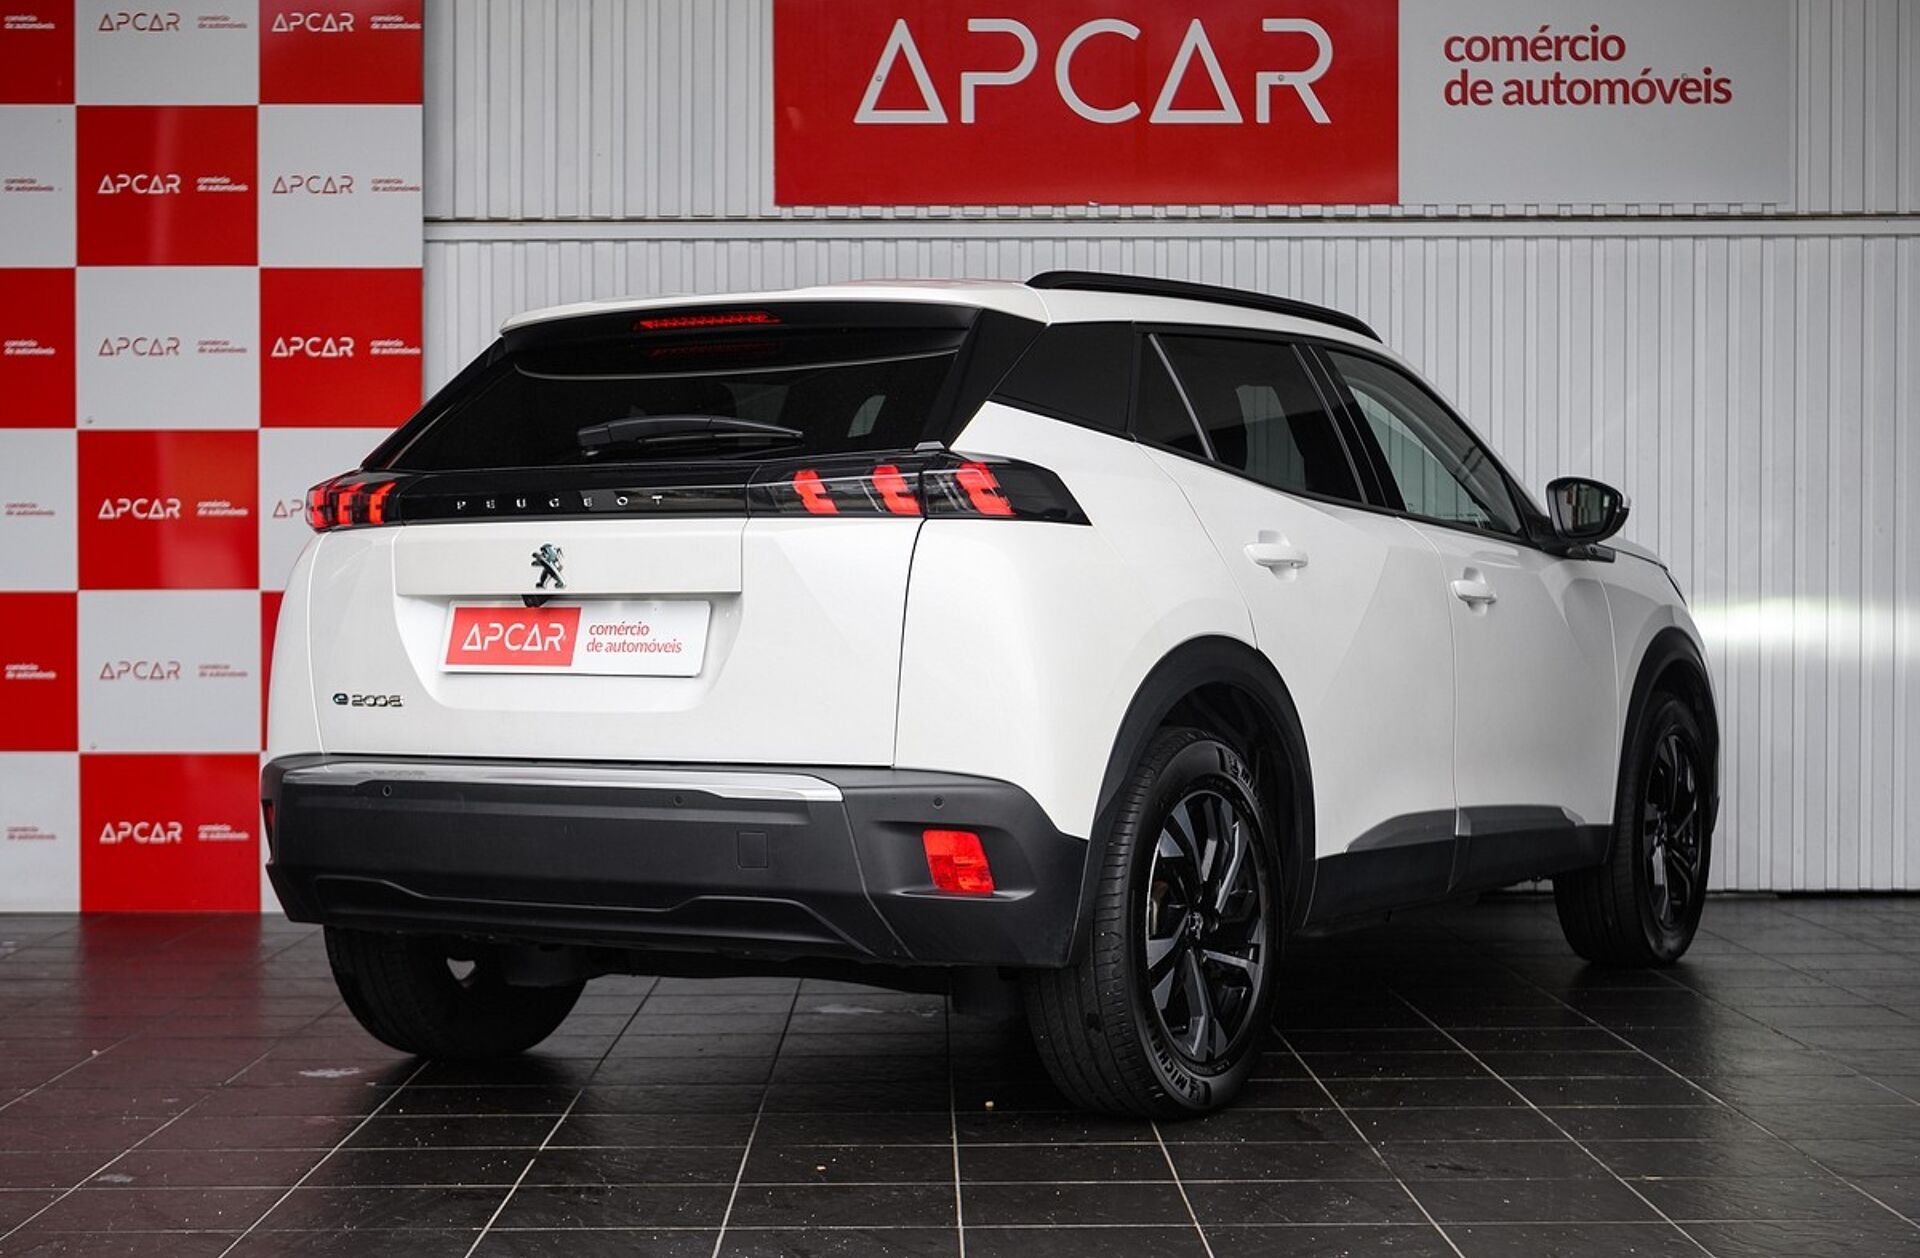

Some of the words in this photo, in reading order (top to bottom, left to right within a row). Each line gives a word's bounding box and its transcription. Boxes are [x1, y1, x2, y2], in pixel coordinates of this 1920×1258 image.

[98, 12, 181, 32] APCAR
[271, 12, 355, 33] APCAR
[1444, 24, 1627, 63] comércio
[853, 18, 1334, 124] APCAR
[1444, 68, 1494, 106] de
[1503, 66, 1733, 106] automóveis
[97, 174, 182, 195] APCAR
[271, 174, 354, 195] APCAR
[98, 336, 181, 357] APCAR
[270, 336, 355, 358] APCAR
[98, 497, 182, 520] APCAR
[456, 494, 663, 510] PEUGEOT
[462, 622, 567, 651] APCAR
[588, 620, 650, 637] comércio
[586, 636, 604, 653] de
[605, 637, 682, 654] automóveis
[99, 660, 181, 681] APCAR
[99, 821, 183, 844] APCAR
